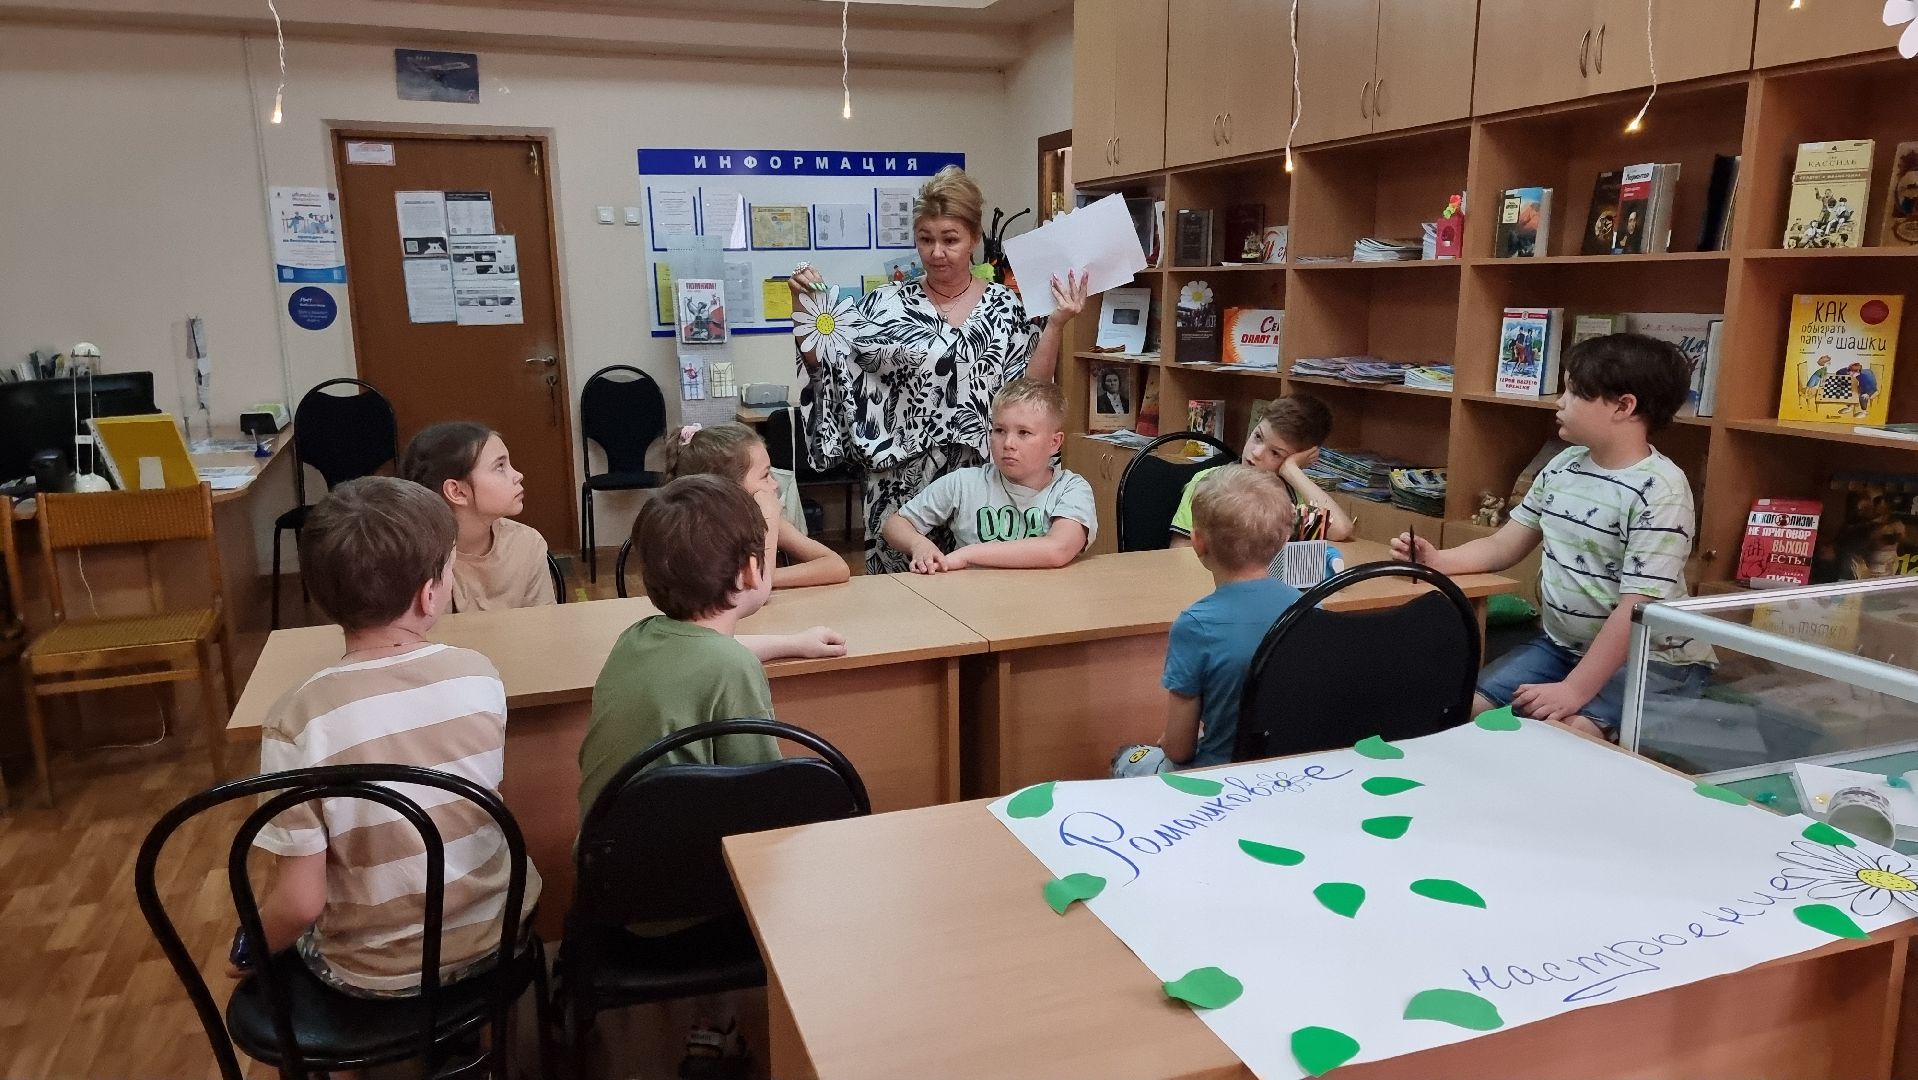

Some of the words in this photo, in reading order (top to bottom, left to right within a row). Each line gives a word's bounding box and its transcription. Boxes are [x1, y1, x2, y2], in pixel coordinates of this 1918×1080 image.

[693, 155, 918, 173] ИНФОРМАЦИЯ
[1814, 301, 1848, 323] КАК
[1801, 321, 1846, 337] обыграть
[1800, 335, 1823, 349] папу
[1826, 337, 1834, 345] в
[1835, 336, 1887, 351] шашки
[1747, 526, 1760, 536] НЕ
[1761, 528, 1812, 541] ПРИГОВОР
[1771, 539, 1810, 557] ВЫХОД
[1770, 553, 1806, 566] ЕСТЬ!
[1462, 874, 1819, 1003] настроение
